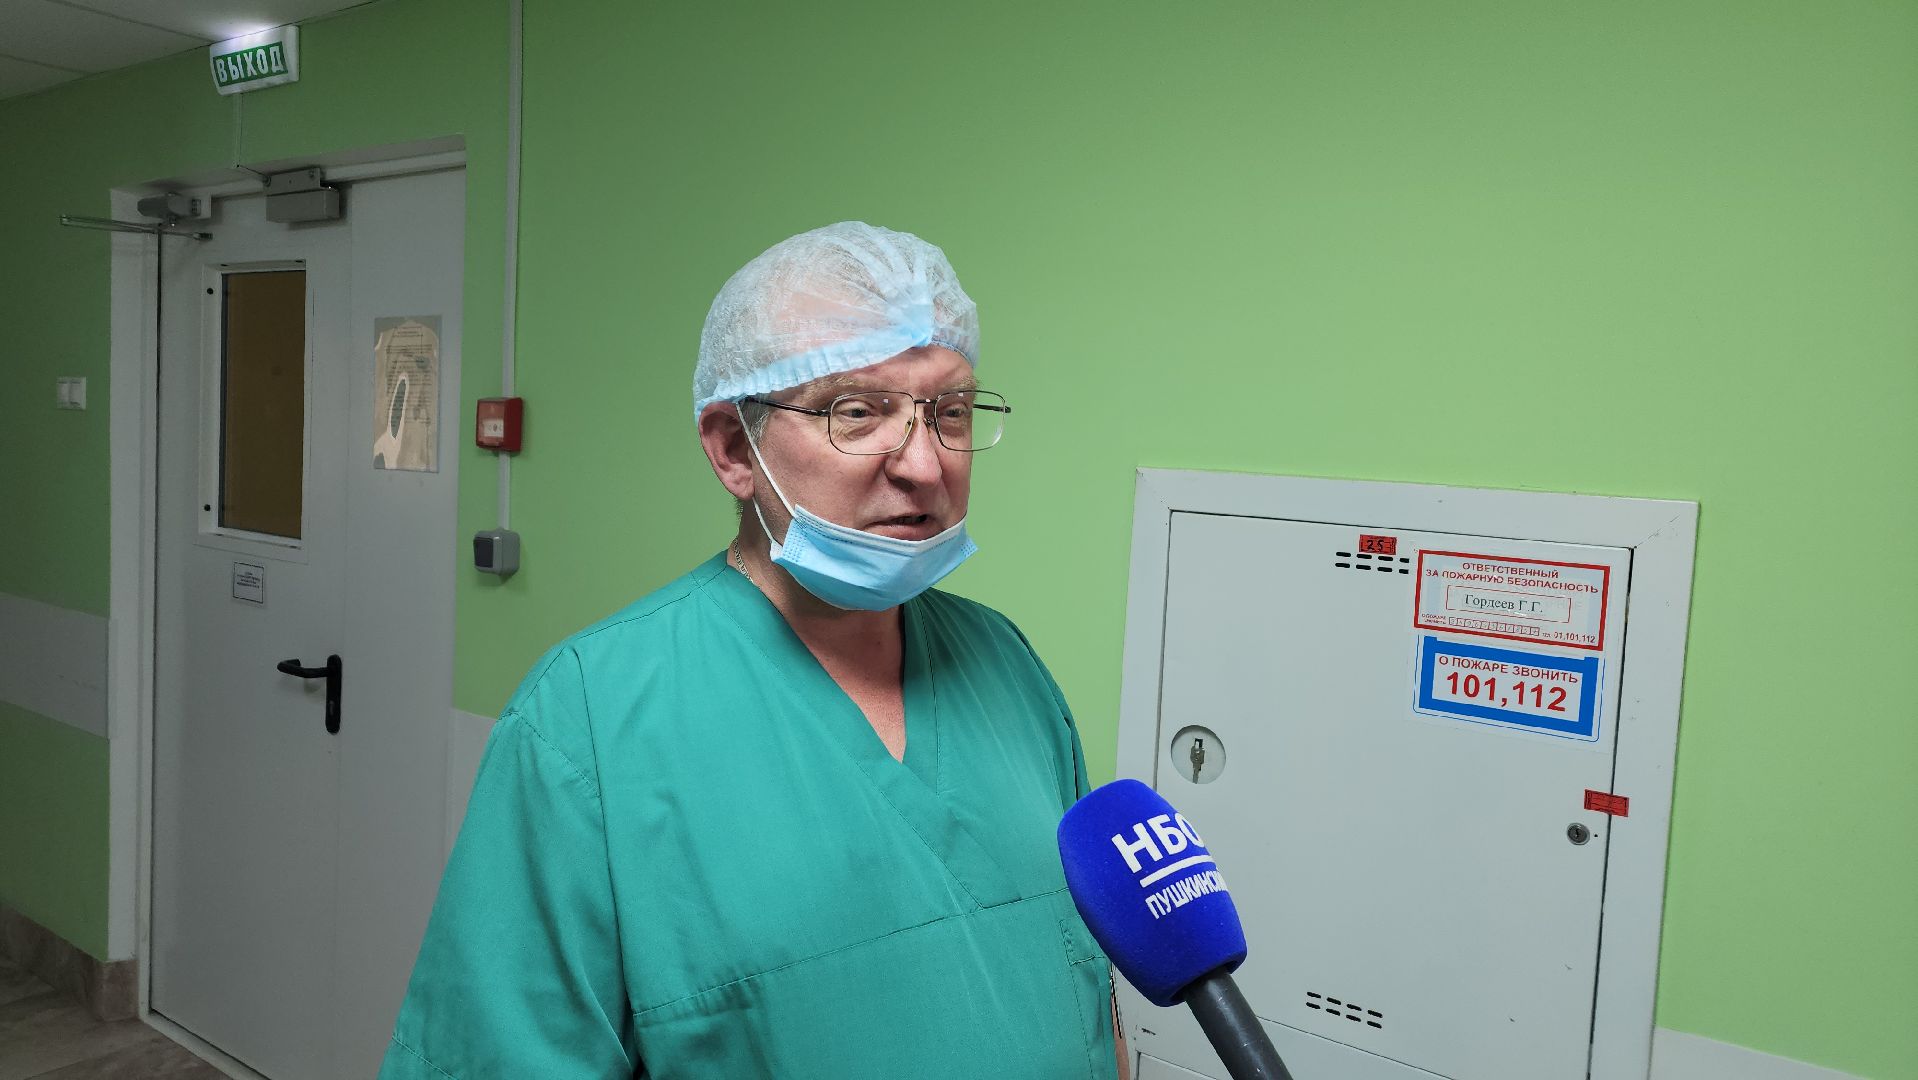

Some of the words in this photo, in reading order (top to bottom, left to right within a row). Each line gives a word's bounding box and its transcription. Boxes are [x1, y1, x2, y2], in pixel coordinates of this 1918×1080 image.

[215, 45, 284, 83] ВЫХОД
[1425, 569, 1439, 578] ЗА
[1442, 571, 1504, 584] ПОЖАРНУЮ
[1507, 577, 1599, 594] БЕЗОПАСНОСТЬ
[1462, 562, 1559, 579] ОТВЕТСТВЕННЫЙ
[1465, 594, 1515, 609] Гордеев
[1518, 600, 1543, 613] Г.Г.
[1439, 655, 1448, 665] О
[1452, 657, 1508, 674] ПОЖАРЕ
[1512, 666, 1578, 684] ЗВОНИТЬ
[1446, 671, 1567, 712] 101,112
